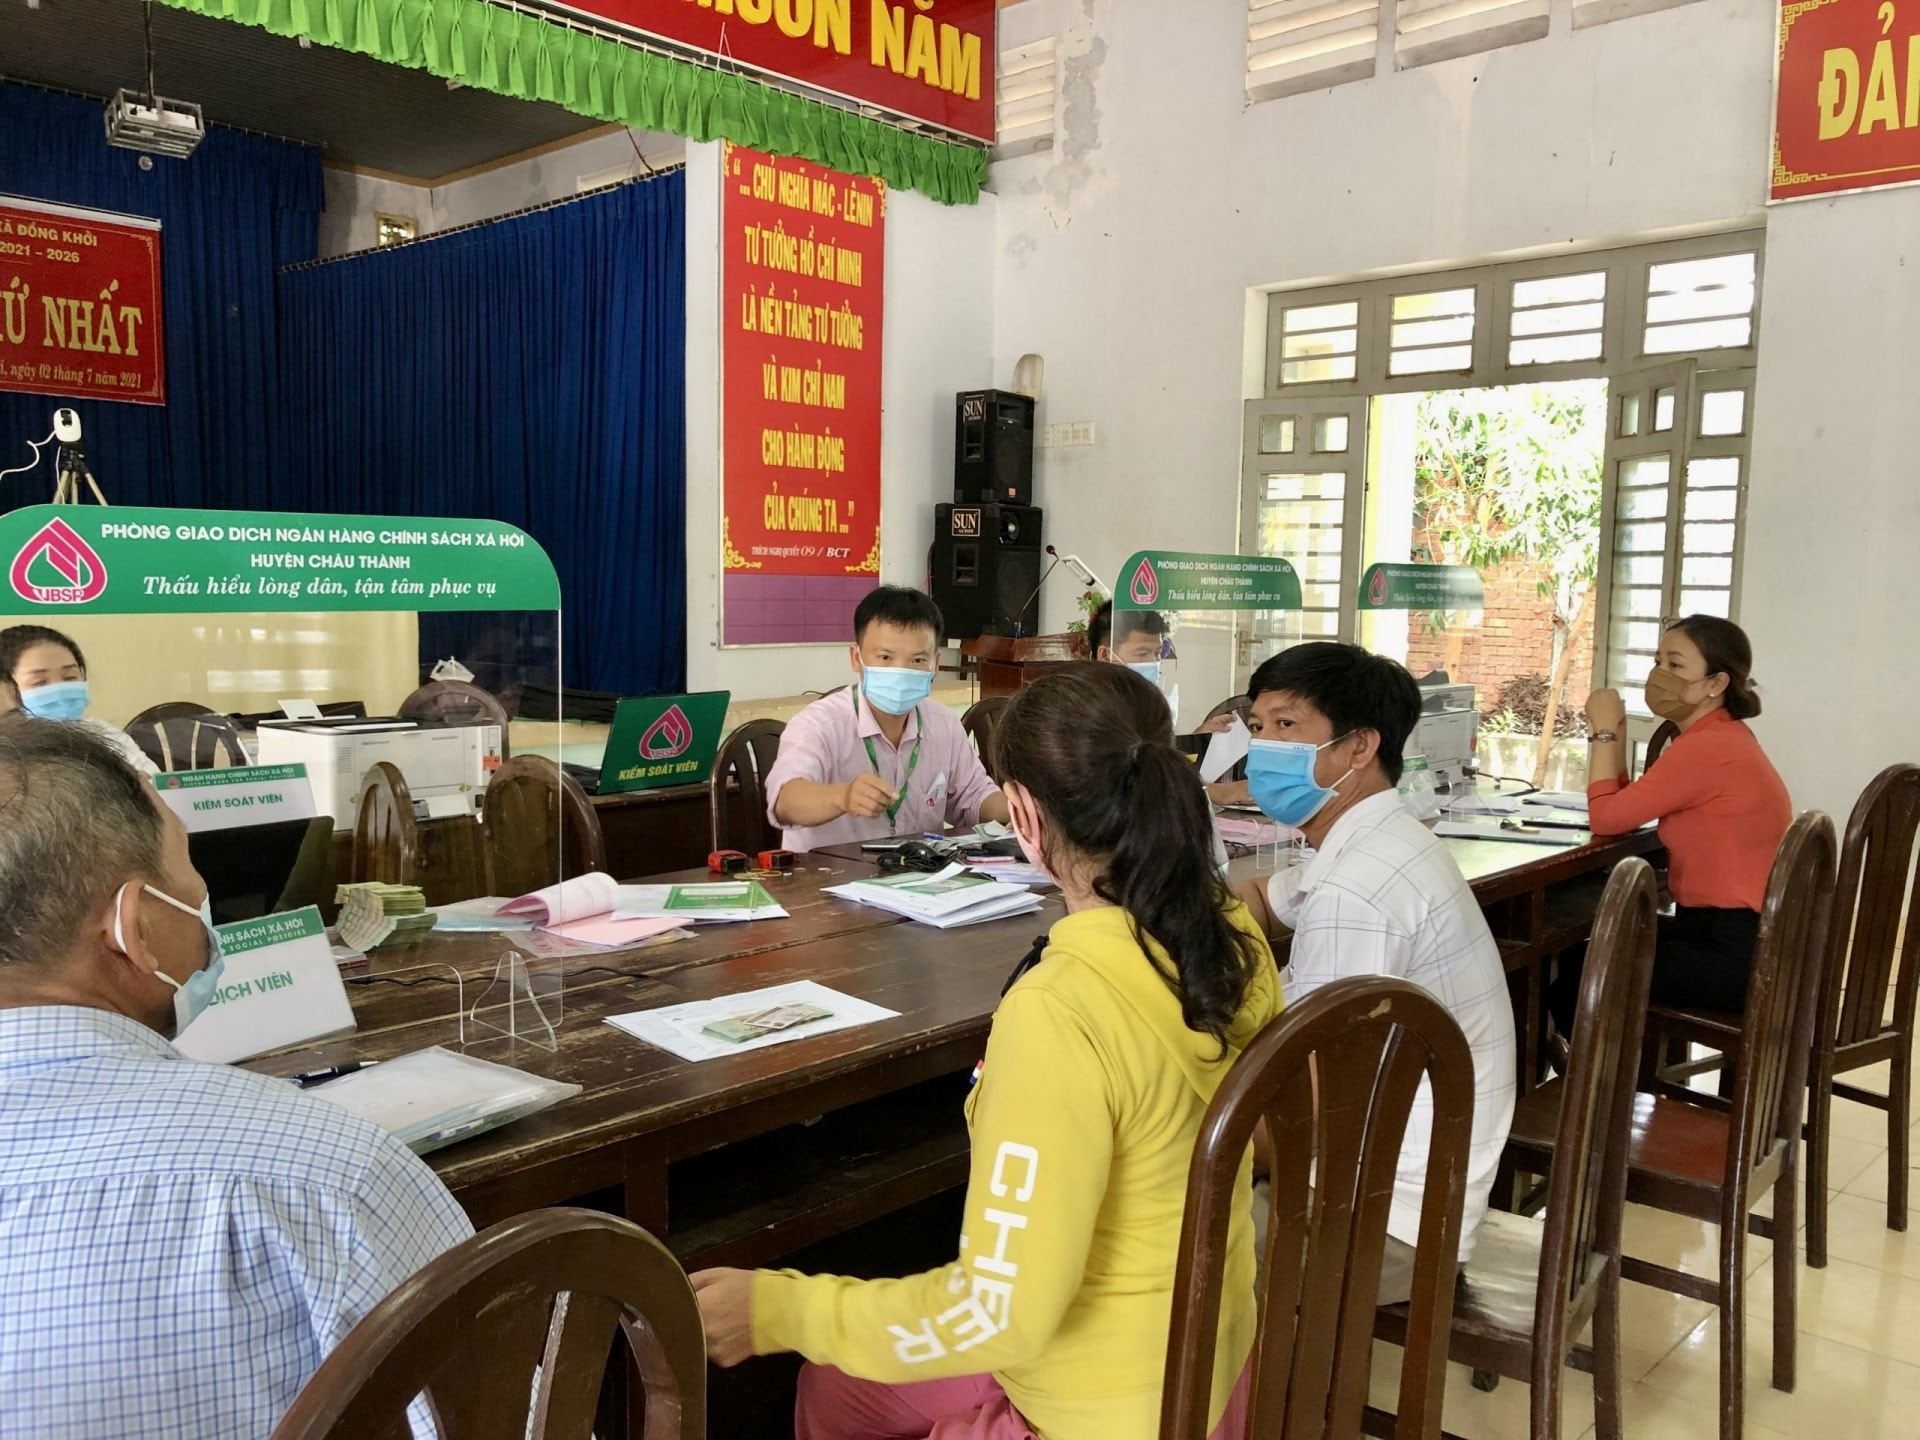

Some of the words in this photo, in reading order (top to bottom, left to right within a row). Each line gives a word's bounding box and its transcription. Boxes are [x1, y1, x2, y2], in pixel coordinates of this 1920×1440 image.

[753, 154, 776, 203] CHỦ
[779, 167, 810, 211] NGHĨA
[812, 173, 836, 218] MÁC
[843, 181, 874, 228] LÊNIN
[47, 248, 80, 263] 2026
[744, 221, 761, 265] TƯ
[762, 219, 798, 274] TƯỞNG
[800, 224, 815, 277] HỒ
[817, 236, 836, 282] CHÍ
[837, 247, 862, 287] MINH
[42, 278, 143, 357] NHẤT
[742, 283, 757, 332] LÀ
[760, 281, 783, 336] NỀN
[785, 288, 812, 341] TẢNG
[814, 302, 830, 345] TƯ
[830, 299, 863, 351] TƯỞNG
[11, 361, 36, 382] ngày
[39, 363, 52, 379] 02
[53, 364, 84, 386] tháng
[87, 368, 93, 383] 7
[95, 370, 118, 386] năm
[120, 371, 142, 388] 2021
[763, 354, 778, 401] VÀ
[781, 366, 801, 404] KIM
[803, 358, 822, 407] CHỈ
[823, 372, 845, 410] NAM
[965, 400, 983, 417] SUN
[762, 428, 784, 467] CHO
[786, 422, 815, 470] HÀNH
[817, 426, 845, 478] ĐỘNG
[764, 481, 786, 531] CỦA
[788, 487, 822, 533] CHÚNG
[824, 499, 837, 533] TA
[954, 513, 977, 529] SUN
[101, 521, 171, 540] PHÒNG
[175, 525, 224, 541] GIAO
[228, 526, 272, 543] DỊCH
[275, 526, 325, 543] NGÂN
[329, 528, 376, 544] HÀNG
[379, 529, 427, 545] CHÍNH
[431, 530, 472, 546] SÁCH
[475, 531, 496, 547] XÃ
[499, 533, 525, 548] HỘI
[251, 552, 305, 570] HUYỆN
[308, 553, 355, 569] CHÂU
[358, 553, 411, 569] THÀNH
[800, 545, 816, 557] 09
[826, 546, 851, 559] BCT
[143, 574, 200, 595] Thấu
[206, 574, 251, 595] hiểu
[258, 576, 302, 598] lòng
[307, 577, 348, 597] dân,
[354, 577, 385, 598] tận
[391, 577, 425, 594] tâm
[428, 578, 472, 598] phục
[477, 583, 497, 598] vụ
[618, 764, 646, 780] KIỂM
[648, 763, 673, 777] SOÁT
[193, 797, 222, 811] KIỂM
[224, 794, 254, 808] SOÁT
[257, 791, 283, 805] VIÊN
[236, 926, 267, 942] SÁCH
[267, 921, 284, 934] XÃ
[284, 917, 304, 930] HỘI
[229, 938, 263, 952] SOCIAL
[254, 970, 294, 993] VIÊN
